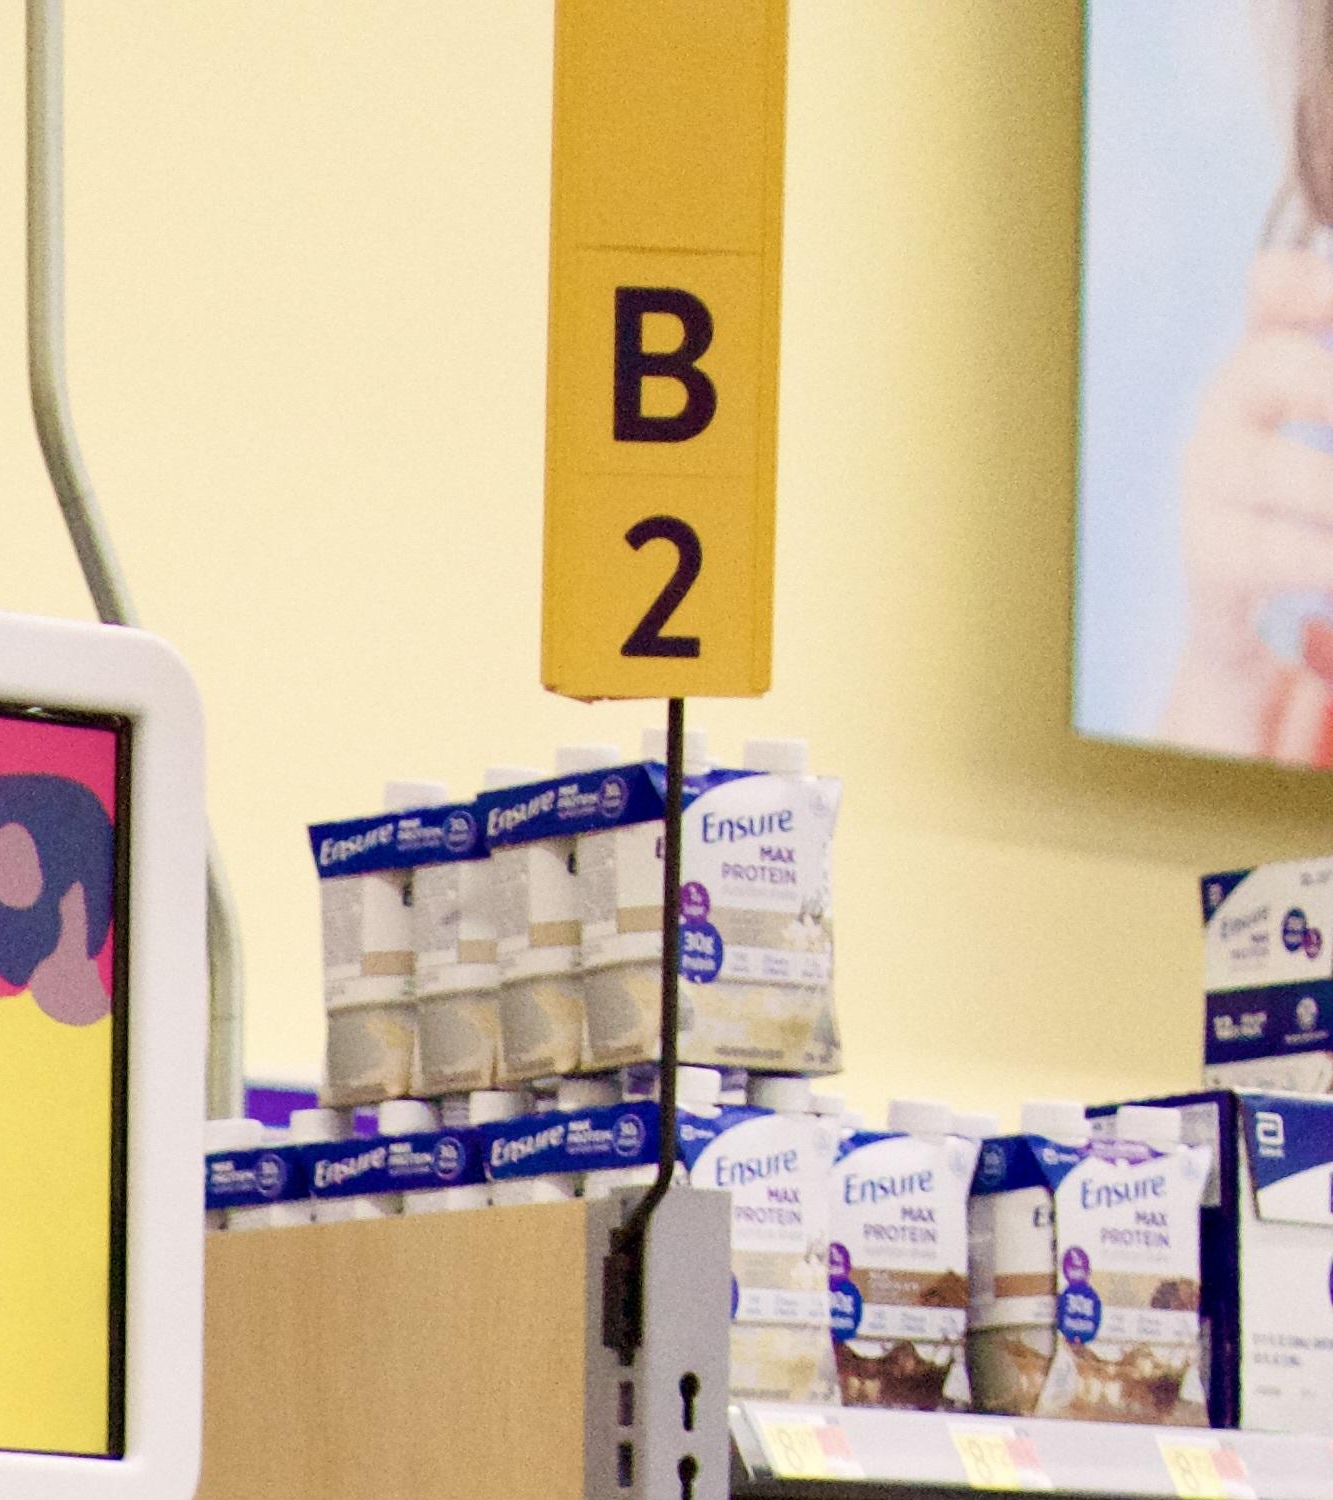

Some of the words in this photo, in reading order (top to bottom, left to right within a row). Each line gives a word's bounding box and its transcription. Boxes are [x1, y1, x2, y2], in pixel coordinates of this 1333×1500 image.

[613, 286, 717, 443] B
[620, 515, 703, 657] 2
[702, 808, 795, 844] Ensure
[760, 846, 795, 863] MAX
[721, 863, 796, 885] PROTEIN
[491, 1125, 565, 1167] Ensure
[314, 1146, 386, 1189] Ensure
[715, 1149, 798, 1187] Ensure
[766, 1187, 801, 1204] MAX
[844, 1170, 933, 1206] Ensure
[1081, 1174, 1166, 1211] Ensure
[735, 1206, 802, 1225] PROTEIN
[900, 1207, 935, 1224] MAX
[1133, 1210, 1168, 1228] MAX
[863, 1223, 937, 1244] PROTEIN
[1101, 1227, 1171, 1249] PROTEIN
